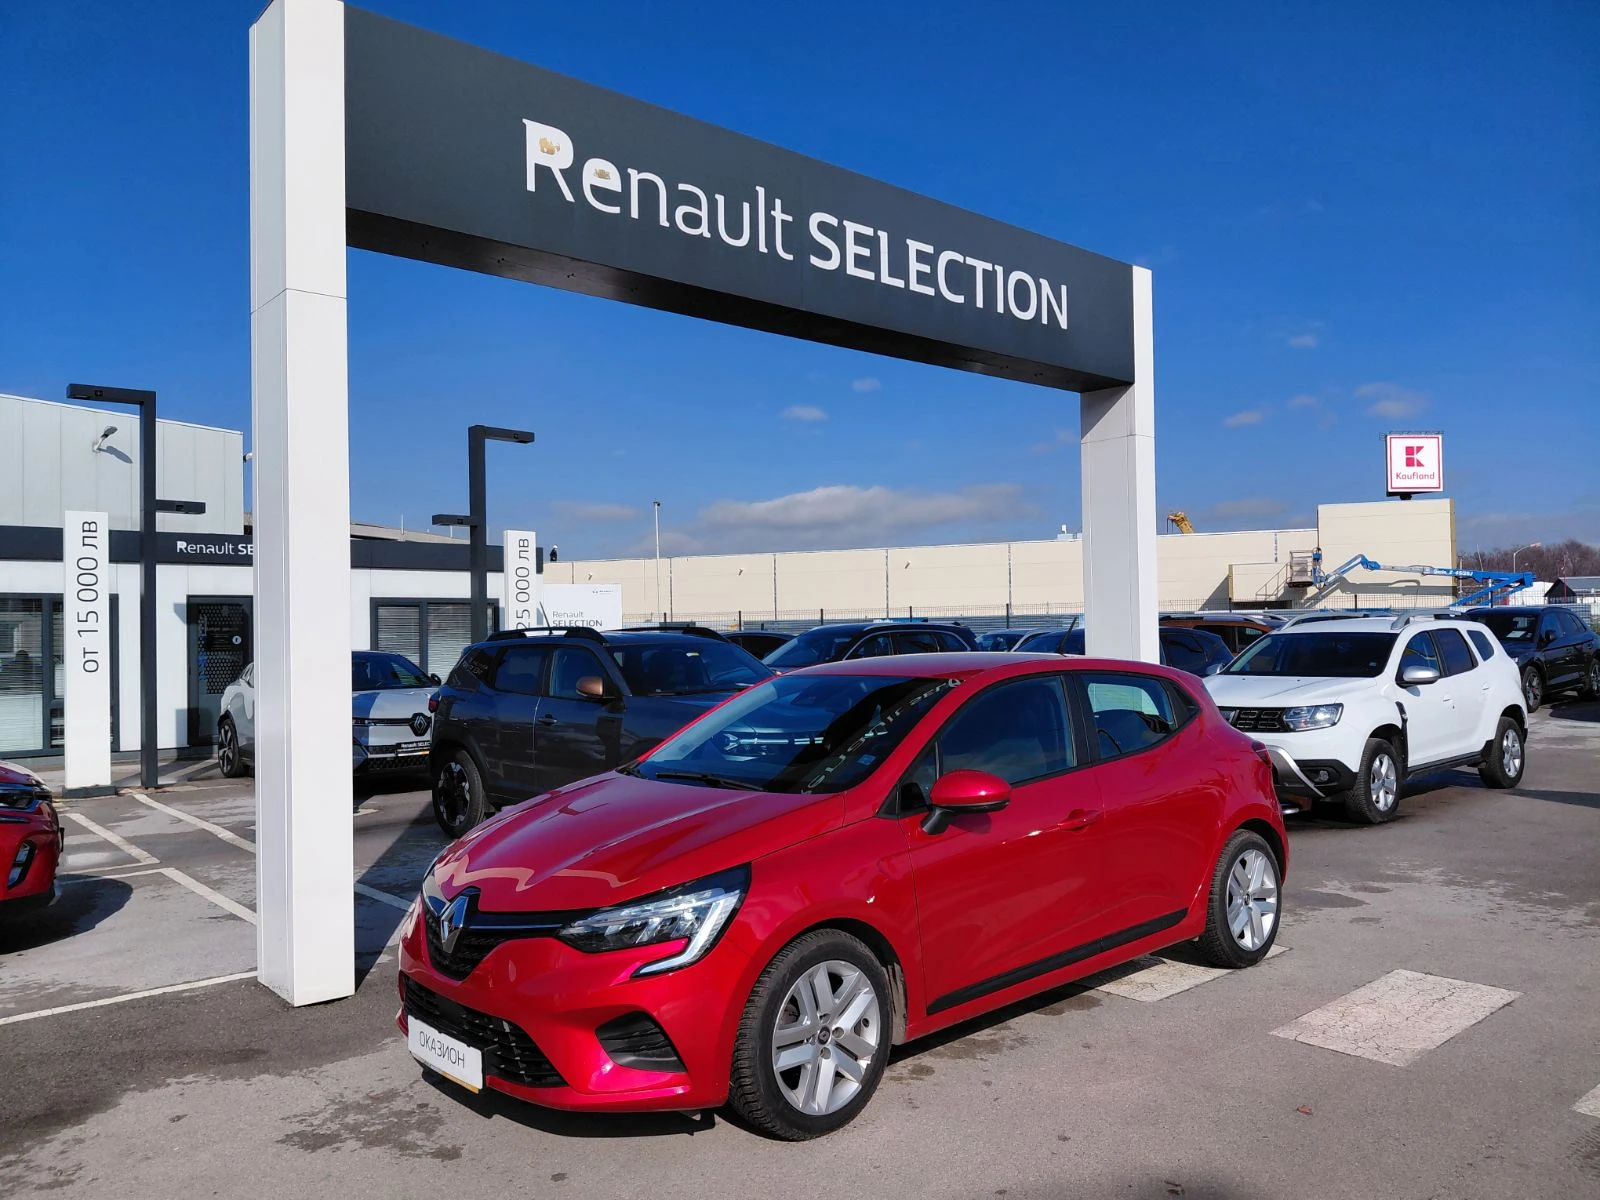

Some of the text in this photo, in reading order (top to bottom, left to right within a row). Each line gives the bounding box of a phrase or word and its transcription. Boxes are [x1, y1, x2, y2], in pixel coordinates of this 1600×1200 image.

[521, 118, 1069, 330] Renault SELECTION
[1395, 471, 1435, 480] Kaufland
[176, 540, 235, 554] Renault
[76, 556, 99, 602] 000
[515, 566, 530, 603] 000
[77, 610, 99, 638] 15
[552, 610, 584, 618] Renault
[552, 619, 603, 627] SELECTION
[419, 1030, 465, 1069] ОКАЗИОН
